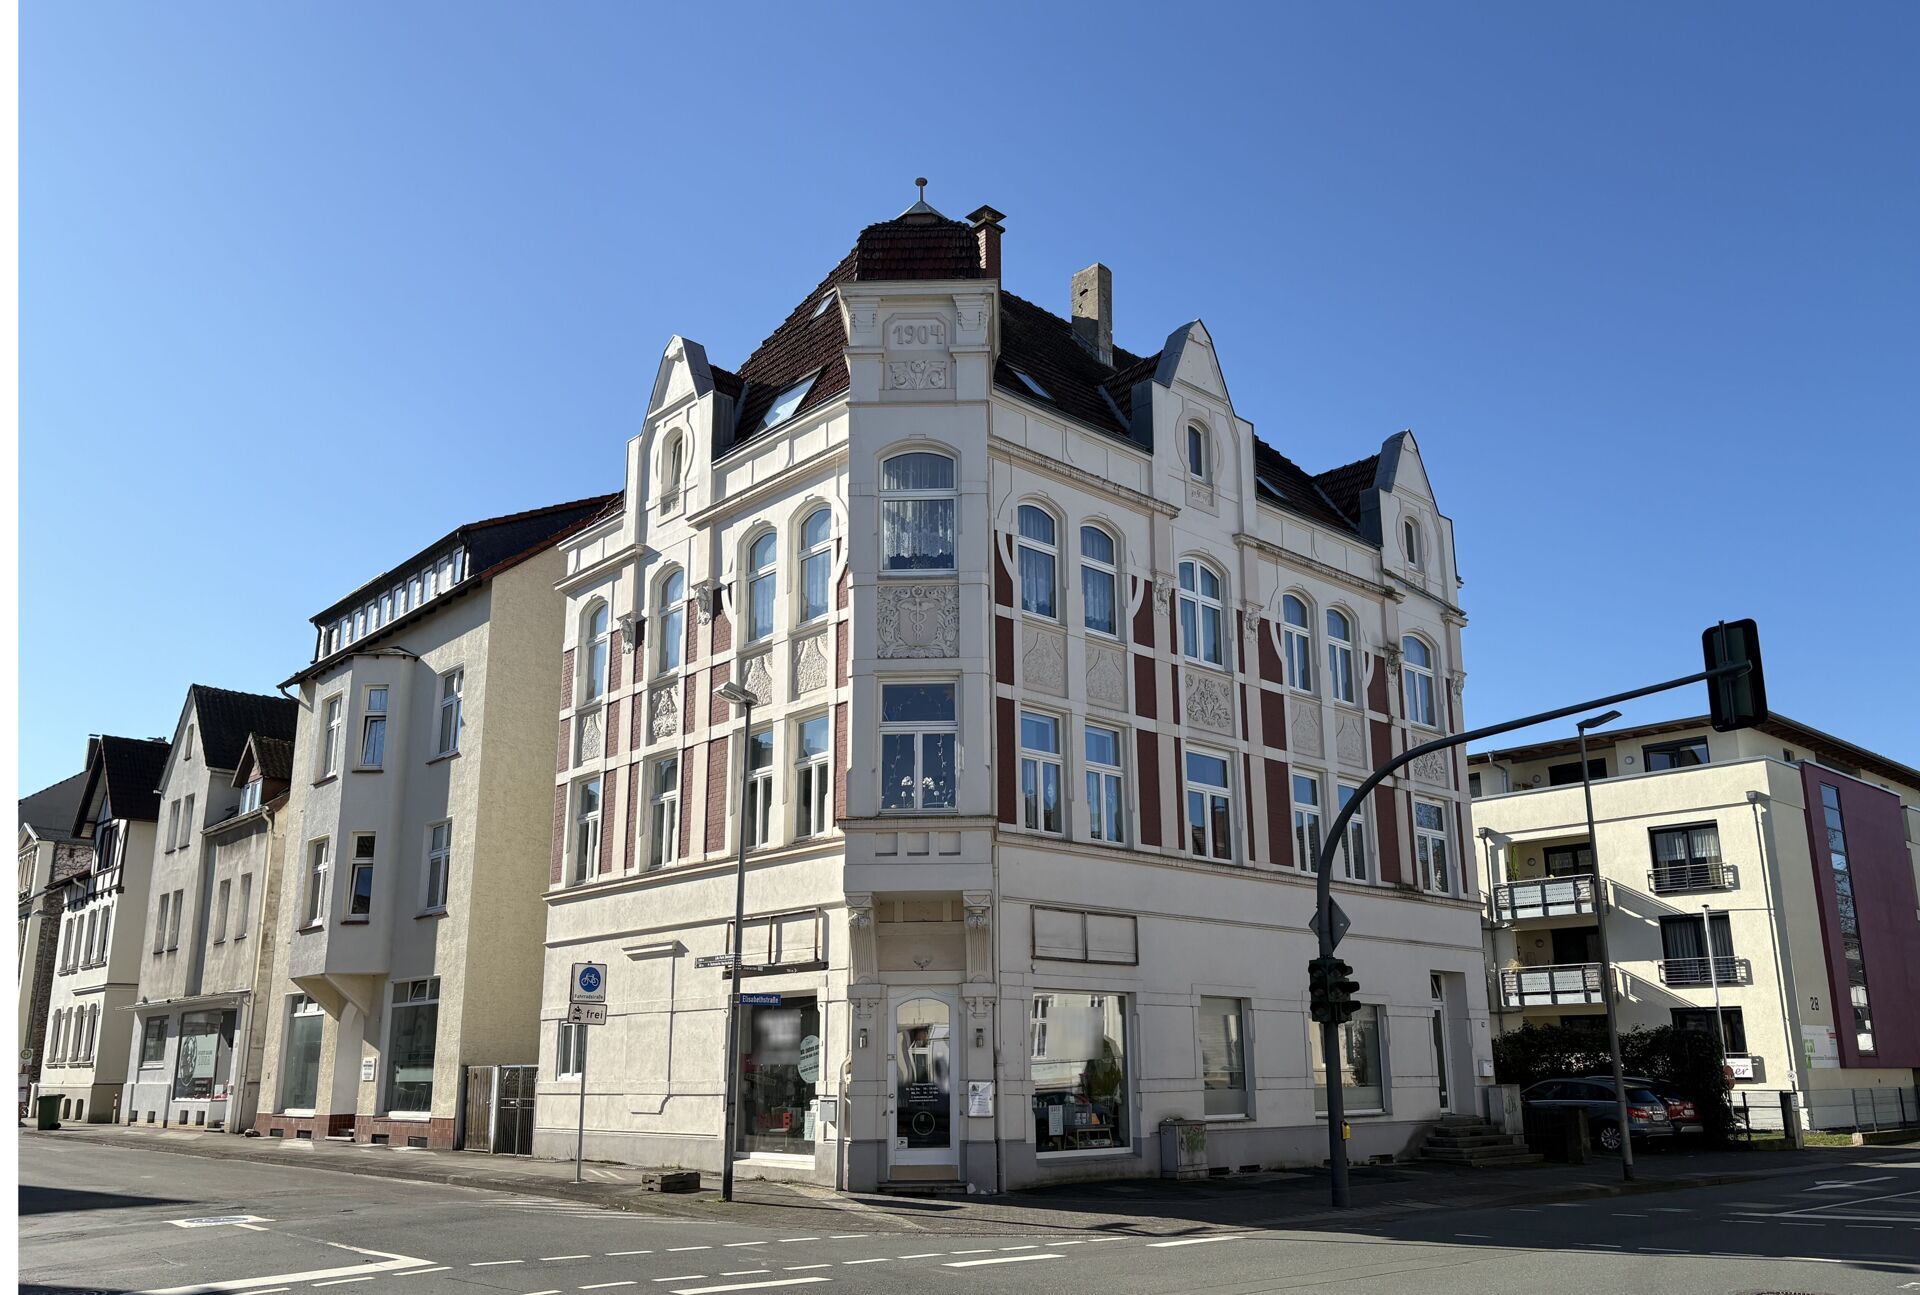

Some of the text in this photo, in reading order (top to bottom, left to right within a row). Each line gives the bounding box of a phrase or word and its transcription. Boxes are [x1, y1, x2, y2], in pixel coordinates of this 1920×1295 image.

[892, 324, 944, 345] 1904
[742, 995, 779, 1004] Elisabethstraße
[1809, 996, 1820, 1011] 28
[586, 1009, 603, 1019] frei
